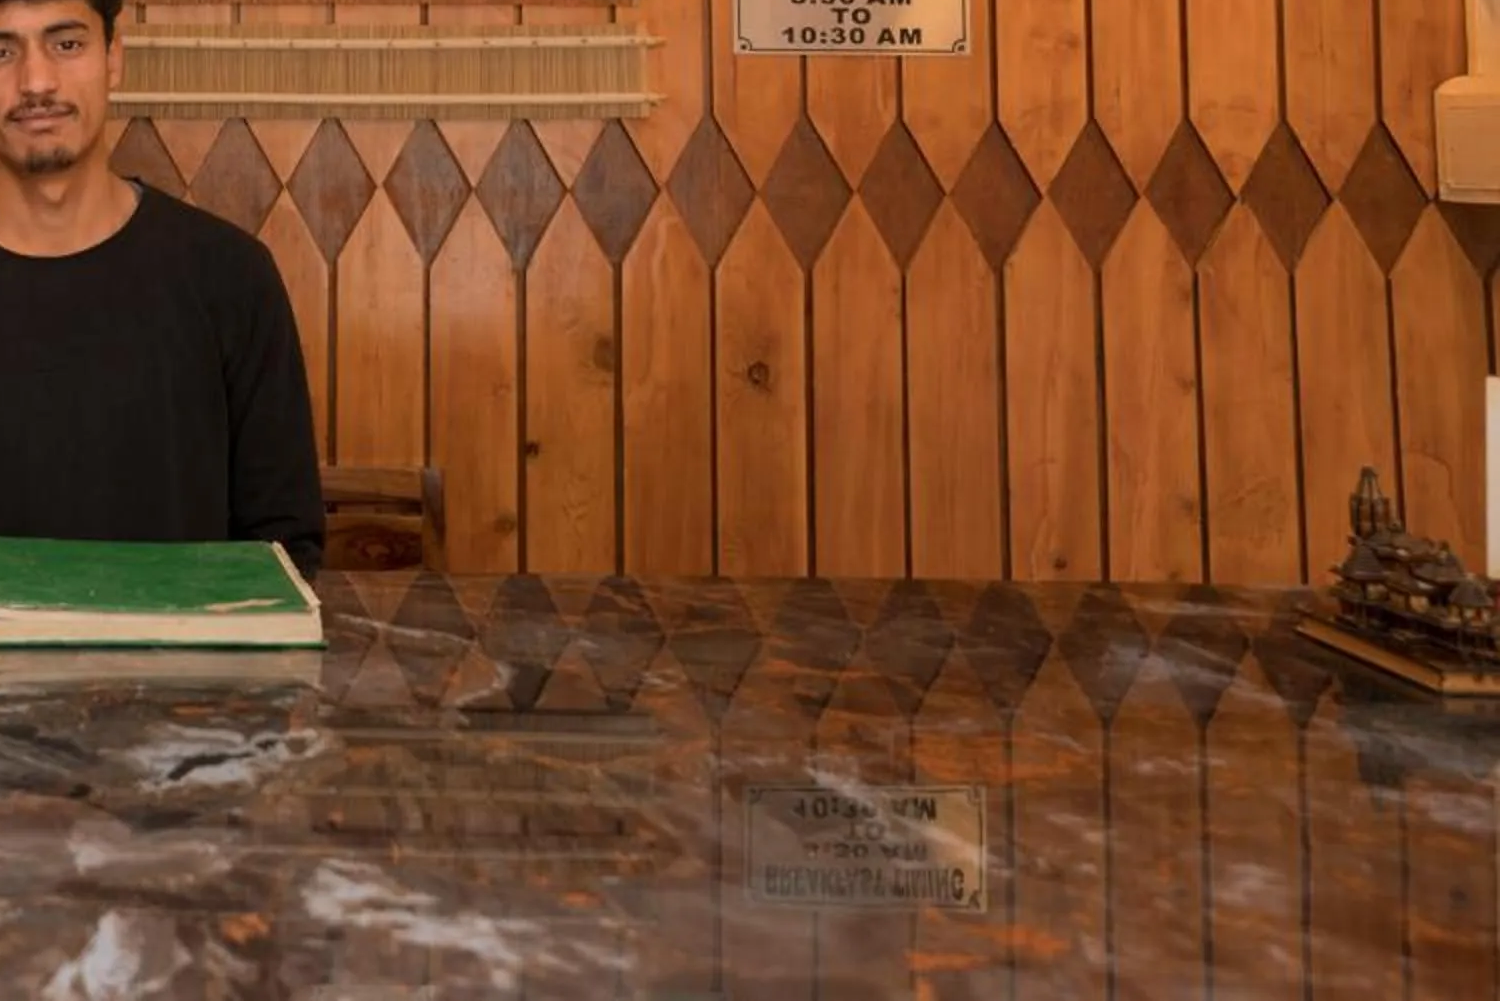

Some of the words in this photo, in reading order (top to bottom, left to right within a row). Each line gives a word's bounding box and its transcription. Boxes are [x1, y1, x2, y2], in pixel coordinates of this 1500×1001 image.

[830, 8, 872, 25] TO
[781, 27, 866, 45] 10:30
[877, 28, 922, 45] AM
